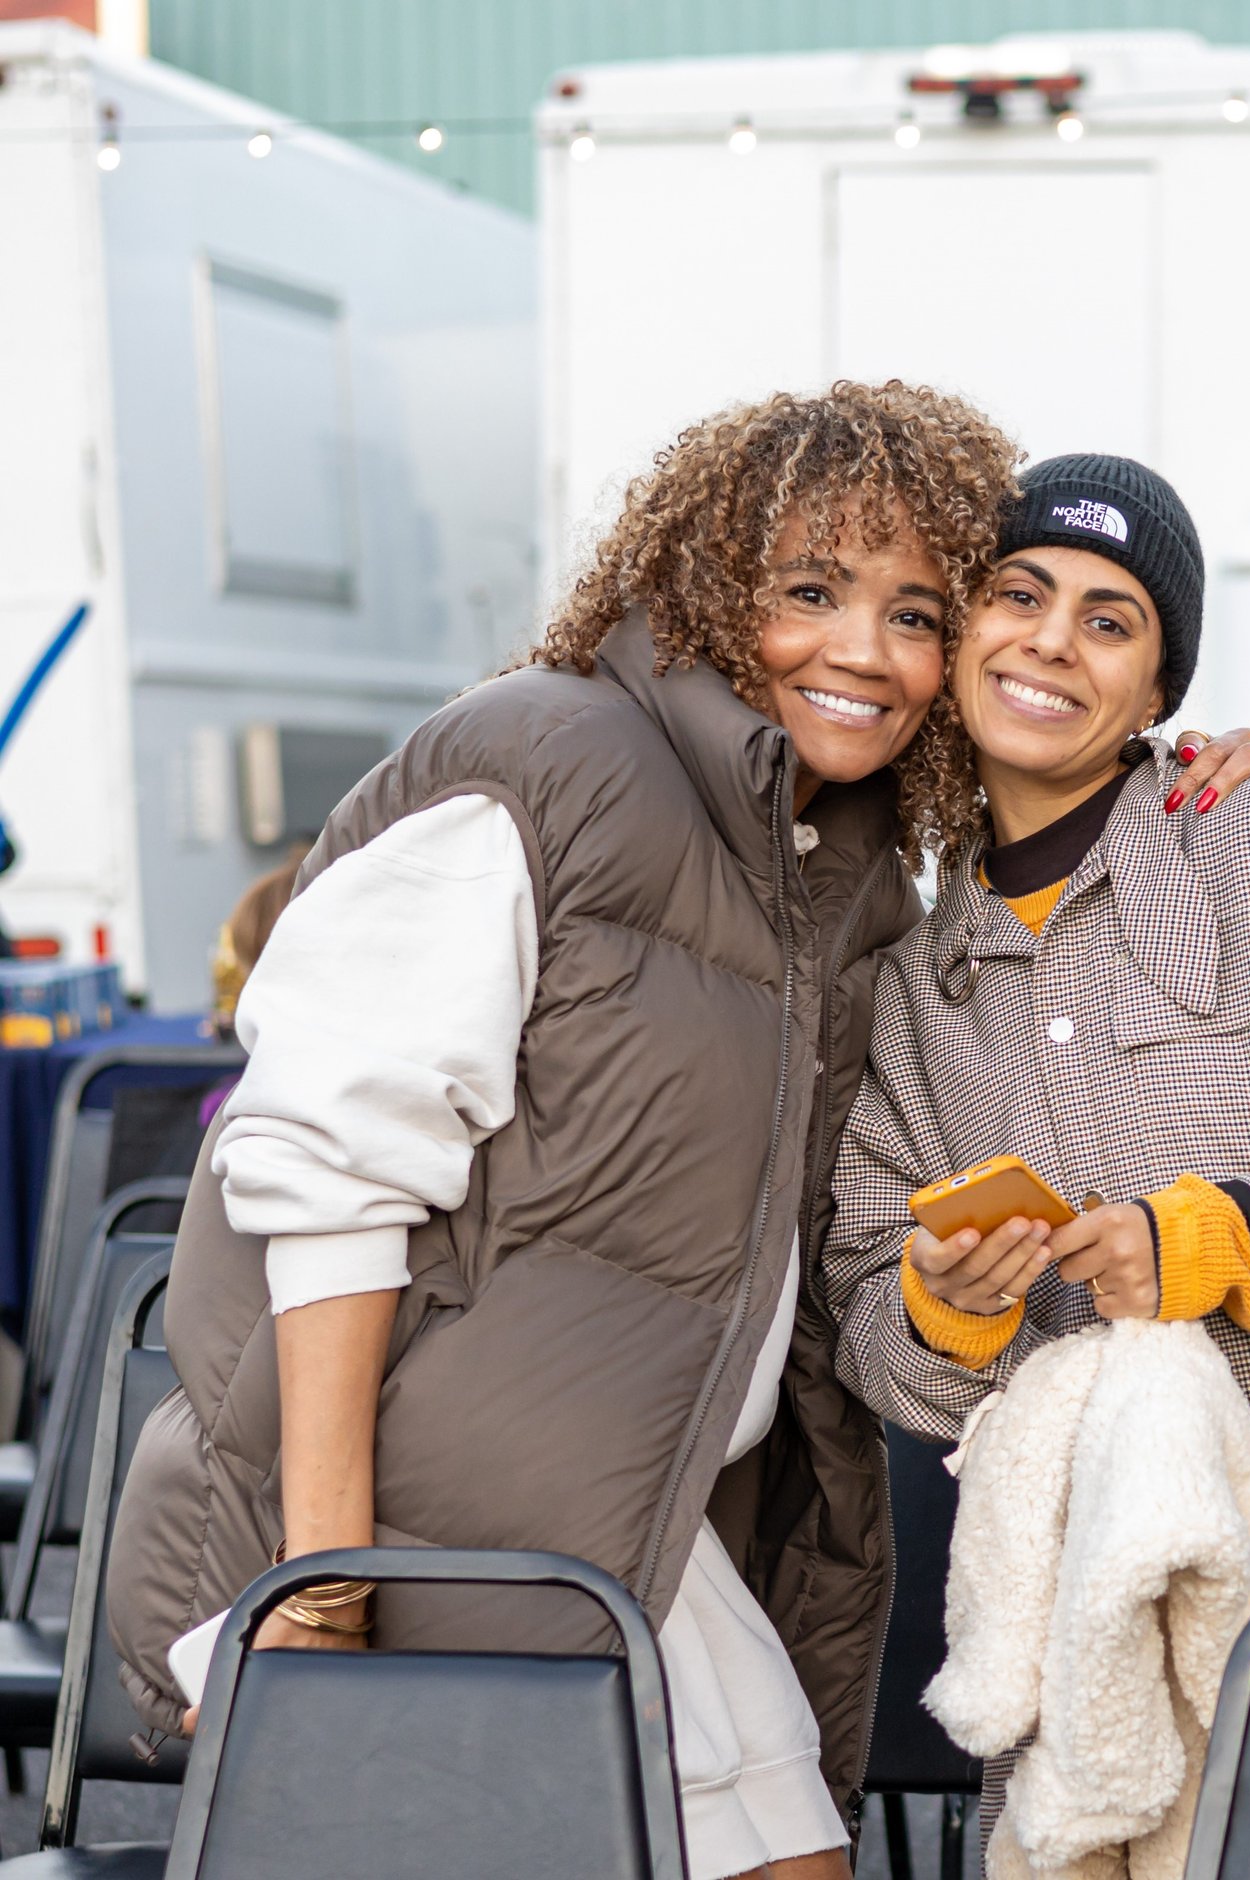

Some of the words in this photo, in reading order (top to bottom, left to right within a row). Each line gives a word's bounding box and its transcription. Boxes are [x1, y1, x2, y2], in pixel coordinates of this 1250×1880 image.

[1052, 506, 1105, 522] NORTH
[1079, 499, 1108, 514] THE
[1064, 516, 1102, 532] FACE
